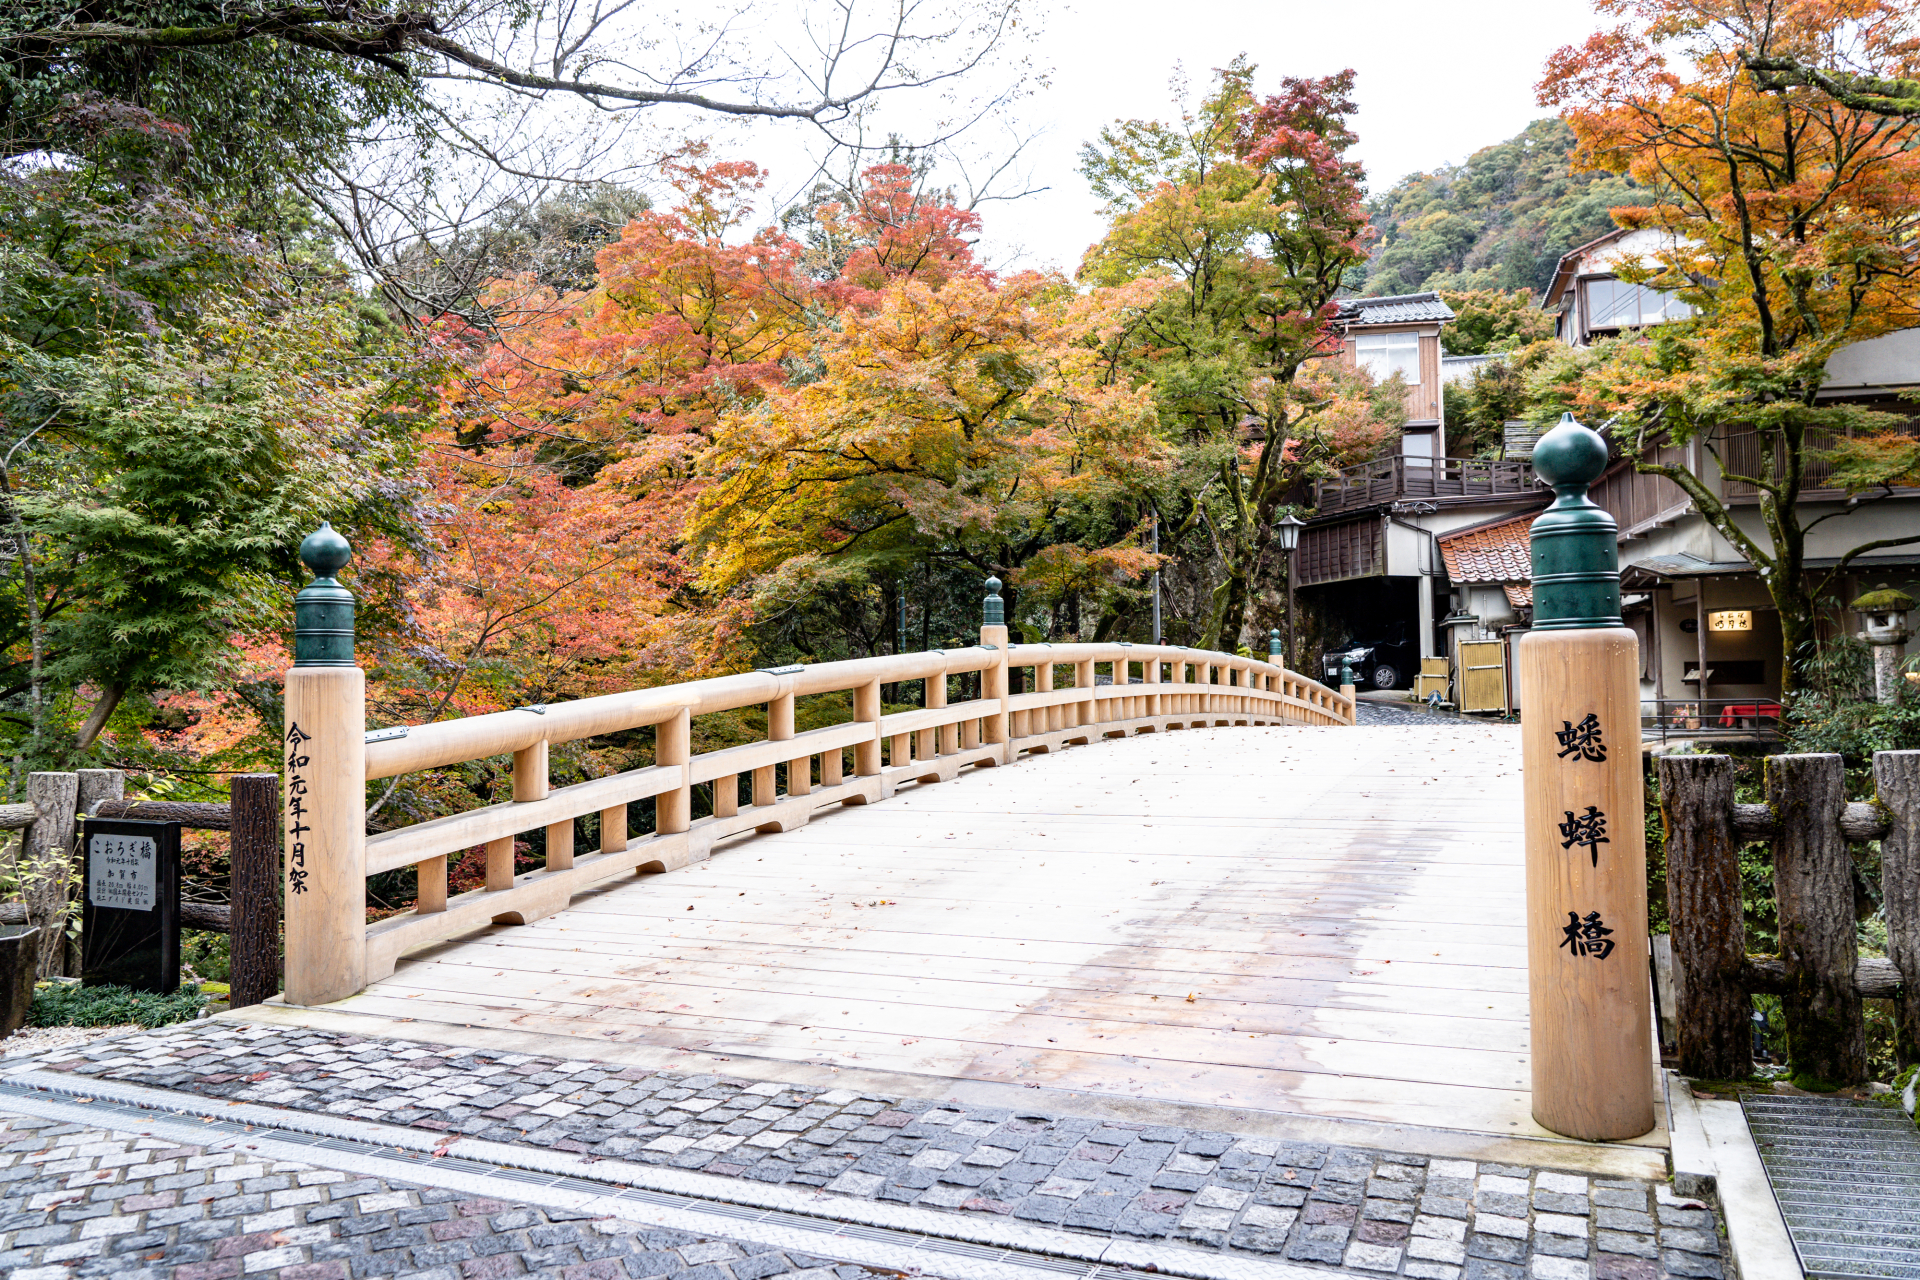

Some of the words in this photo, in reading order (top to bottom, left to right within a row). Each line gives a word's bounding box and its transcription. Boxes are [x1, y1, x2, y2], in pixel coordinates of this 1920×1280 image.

[286, 721, 312, 895] 令和元年十月架
[1555, 713, 1615, 960] 蟋蟀橋
[94, 840, 151, 860] こおろぎ橋
[106, 857, 139, 866] 令和元年十月架
[107, 869, 137, 880] 加賀市
